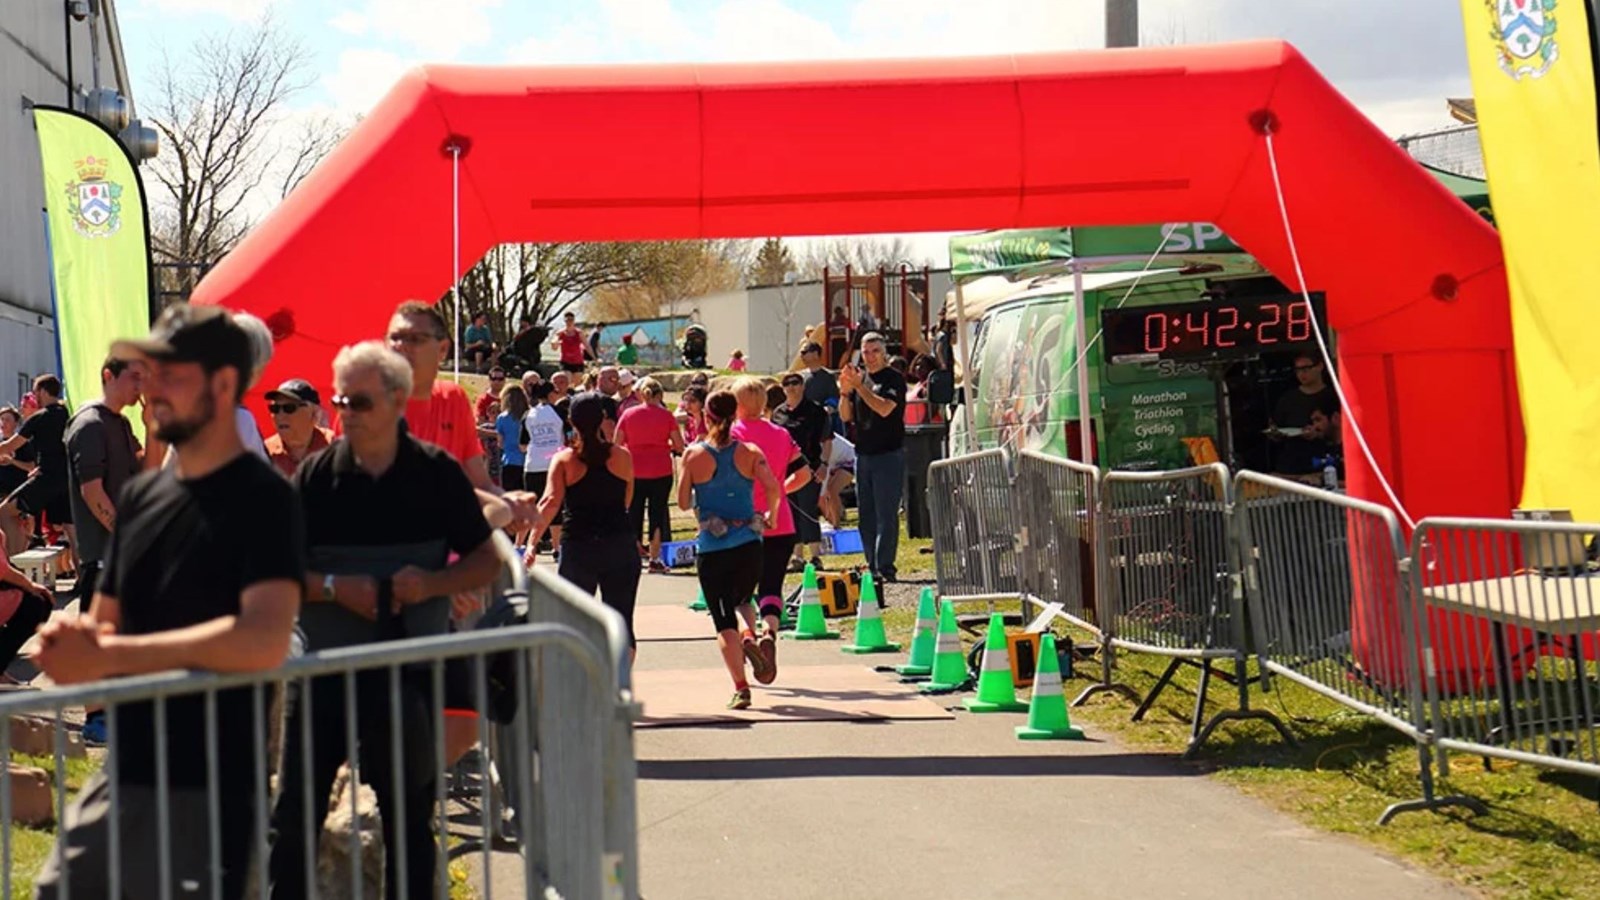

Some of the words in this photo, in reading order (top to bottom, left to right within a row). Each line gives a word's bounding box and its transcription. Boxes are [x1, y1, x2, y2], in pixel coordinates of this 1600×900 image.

[1161, 222, 1244, 252] SP
[1131, 391, 1187, 405] Marathon
[1134, 407, 1184, 420] Triathlon
[1135, 424, 1175, 438] Cycling
[1136, 440, 1154, 452] Ski
